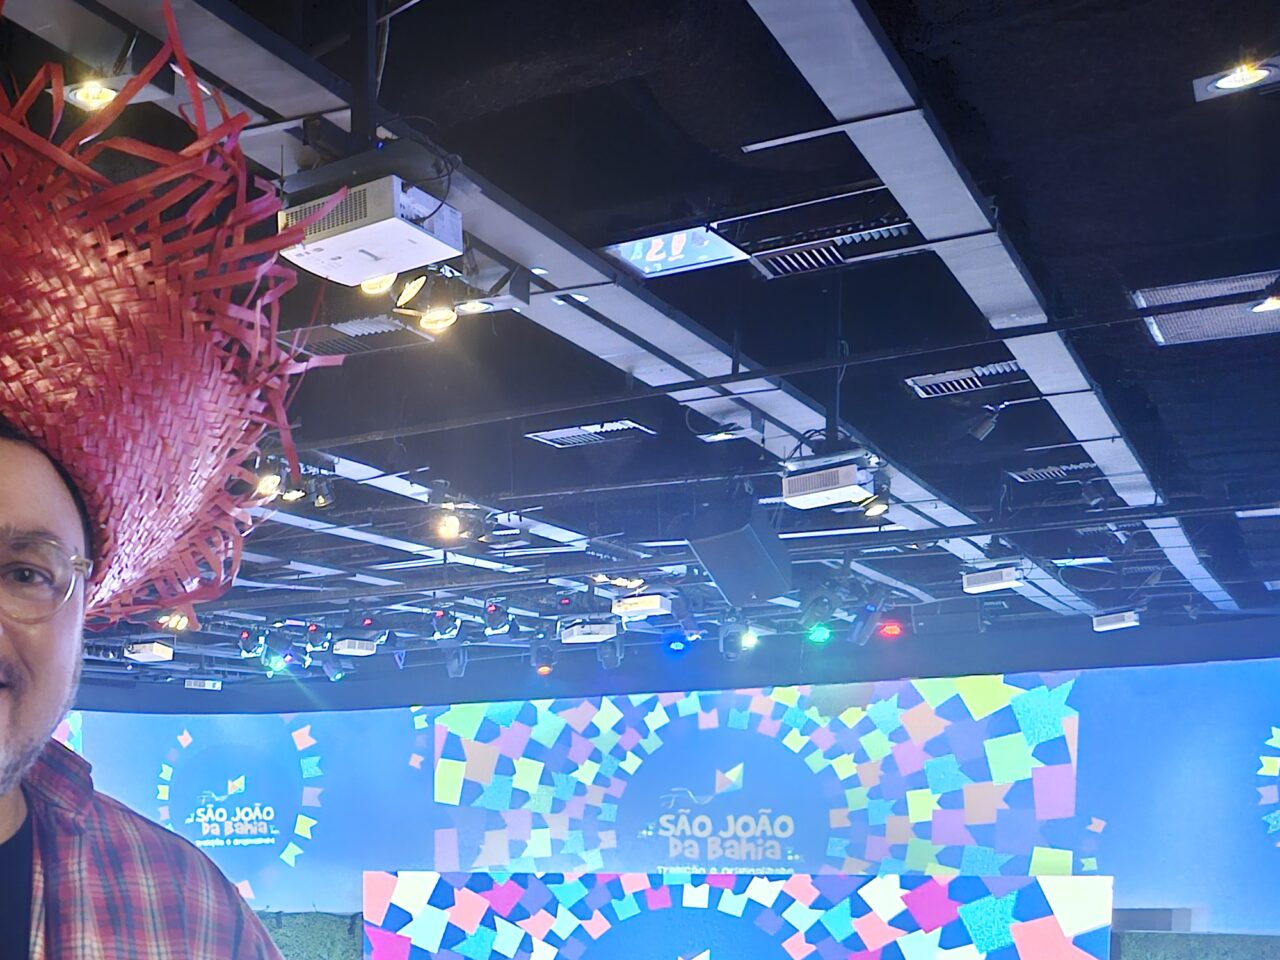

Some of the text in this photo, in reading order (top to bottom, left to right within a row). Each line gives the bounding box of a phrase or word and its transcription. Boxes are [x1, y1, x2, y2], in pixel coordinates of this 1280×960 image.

[195, 802, 275, 822] SÃO JOÃO
[658, 808, 795, 838] SÃO JOÃO
[707, 836, 782, 860] Bahia
